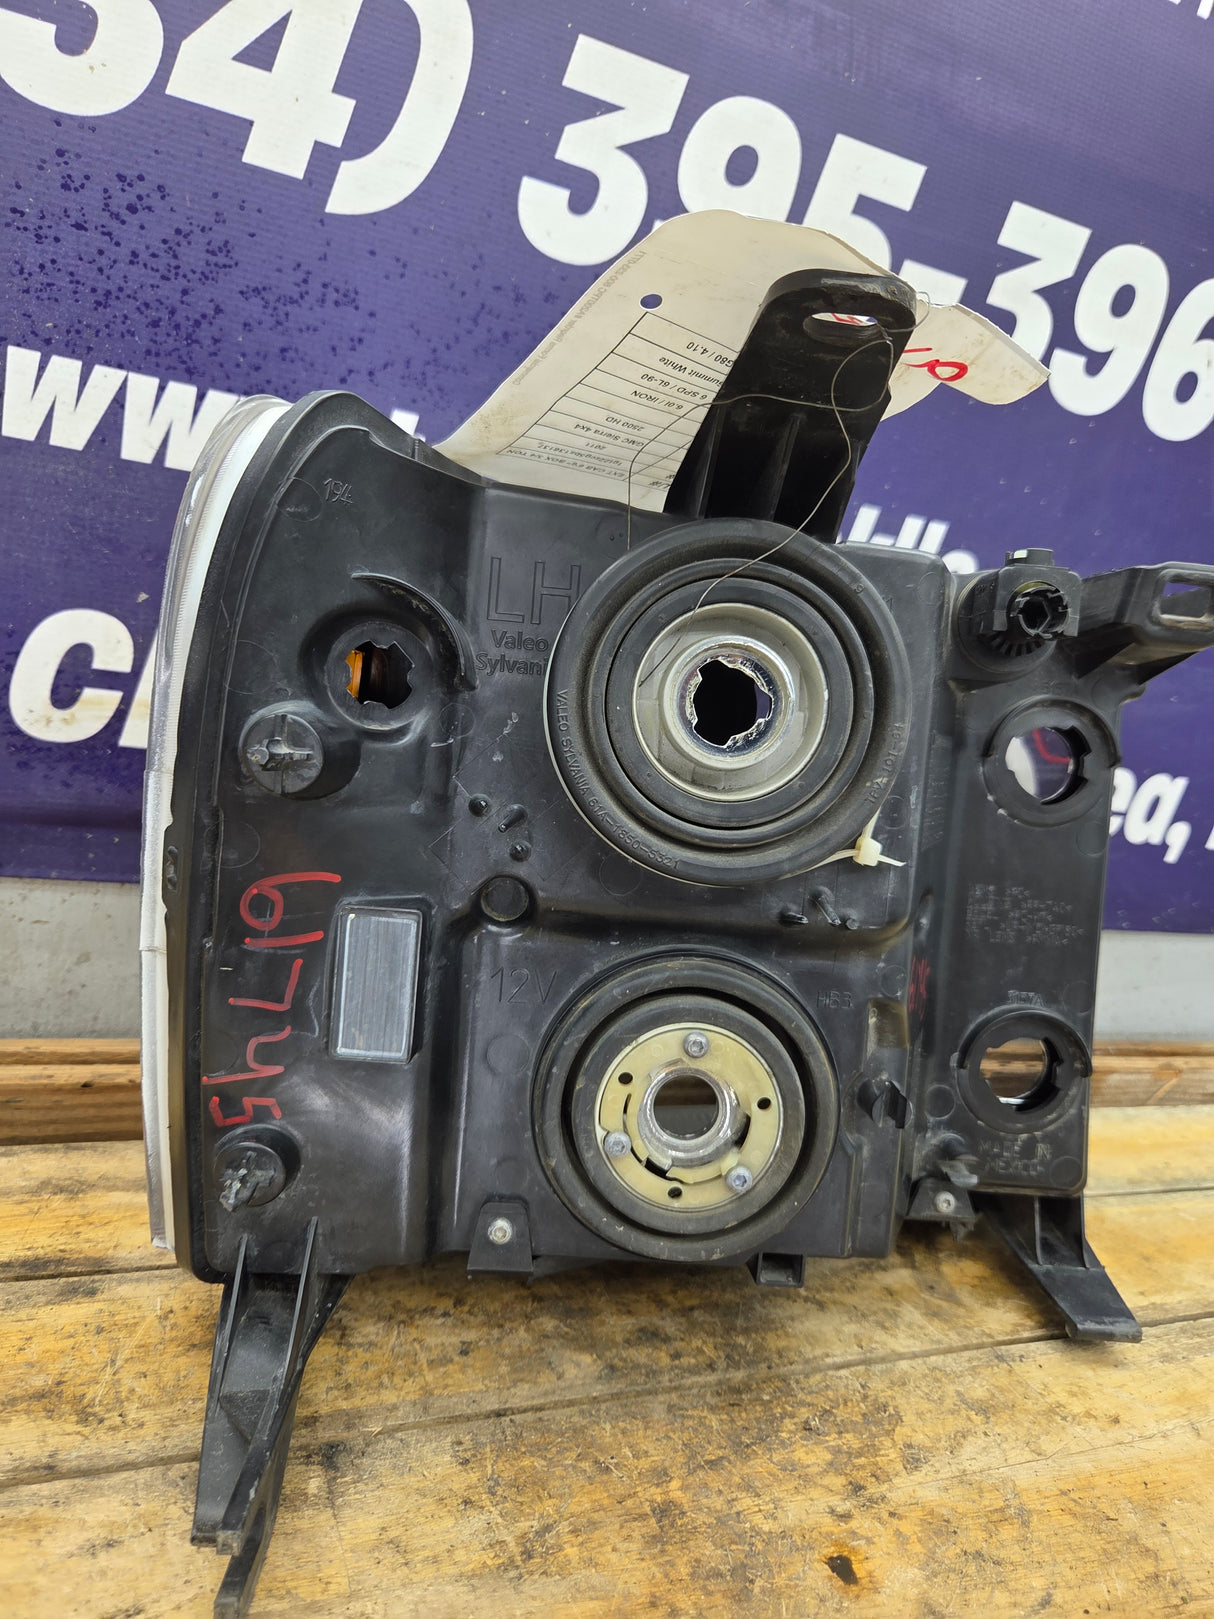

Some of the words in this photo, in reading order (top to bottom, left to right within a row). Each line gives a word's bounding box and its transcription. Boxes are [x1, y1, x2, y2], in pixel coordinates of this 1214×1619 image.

[686, 341, 709, 356] 4.10
[658, 356, 688, 374] White
[640, 373, 671, 388] 6L-90
[630, 390, 660, 403] IRON
[676, 386, 700, 398] SPD
[605, 416, 621, 425] HD
[621, 422, 645, 432] 2500
[574, 423, 593, 433] 4x4
[593, 430, 621, 442] Sierra
[621, 438, 645, 447] GMC
[585, 441, 608, 450] 2011
[487, 557, 581, 625] LH
[491, 630, 549, 652] Valeo
[556, 689, 570, 732] VALEO
[561, 735, 591, 796] SYLVANIA
[490, 965, 558, 1005] 12V
